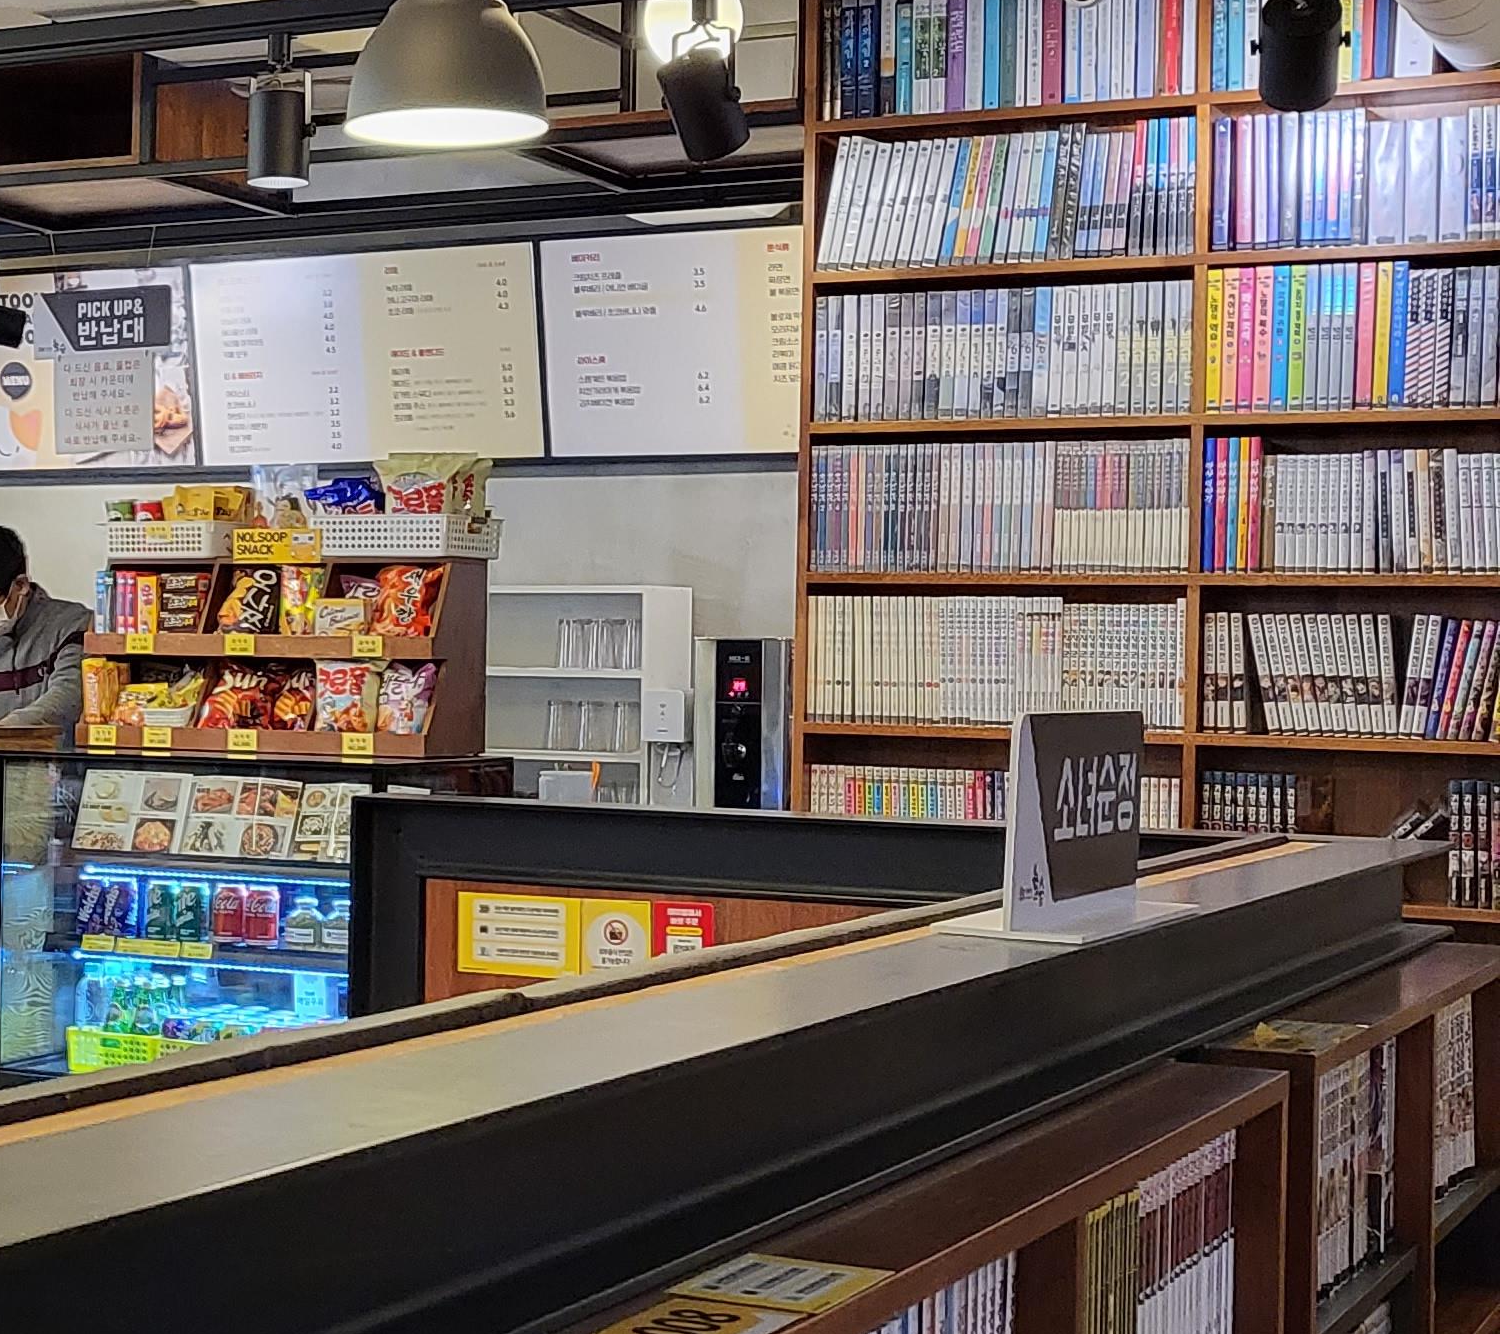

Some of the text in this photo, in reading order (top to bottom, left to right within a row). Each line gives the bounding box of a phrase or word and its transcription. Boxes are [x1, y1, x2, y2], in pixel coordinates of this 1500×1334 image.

[77, 298, 144, 319] PICK UP&
[77, 317, 145, 347] 반납대
[236, 532, 288, 543] NOLSOOP
[236, 543, 274, 556] SNACK
[1053, 753, 1137, 841] 소녀순정
